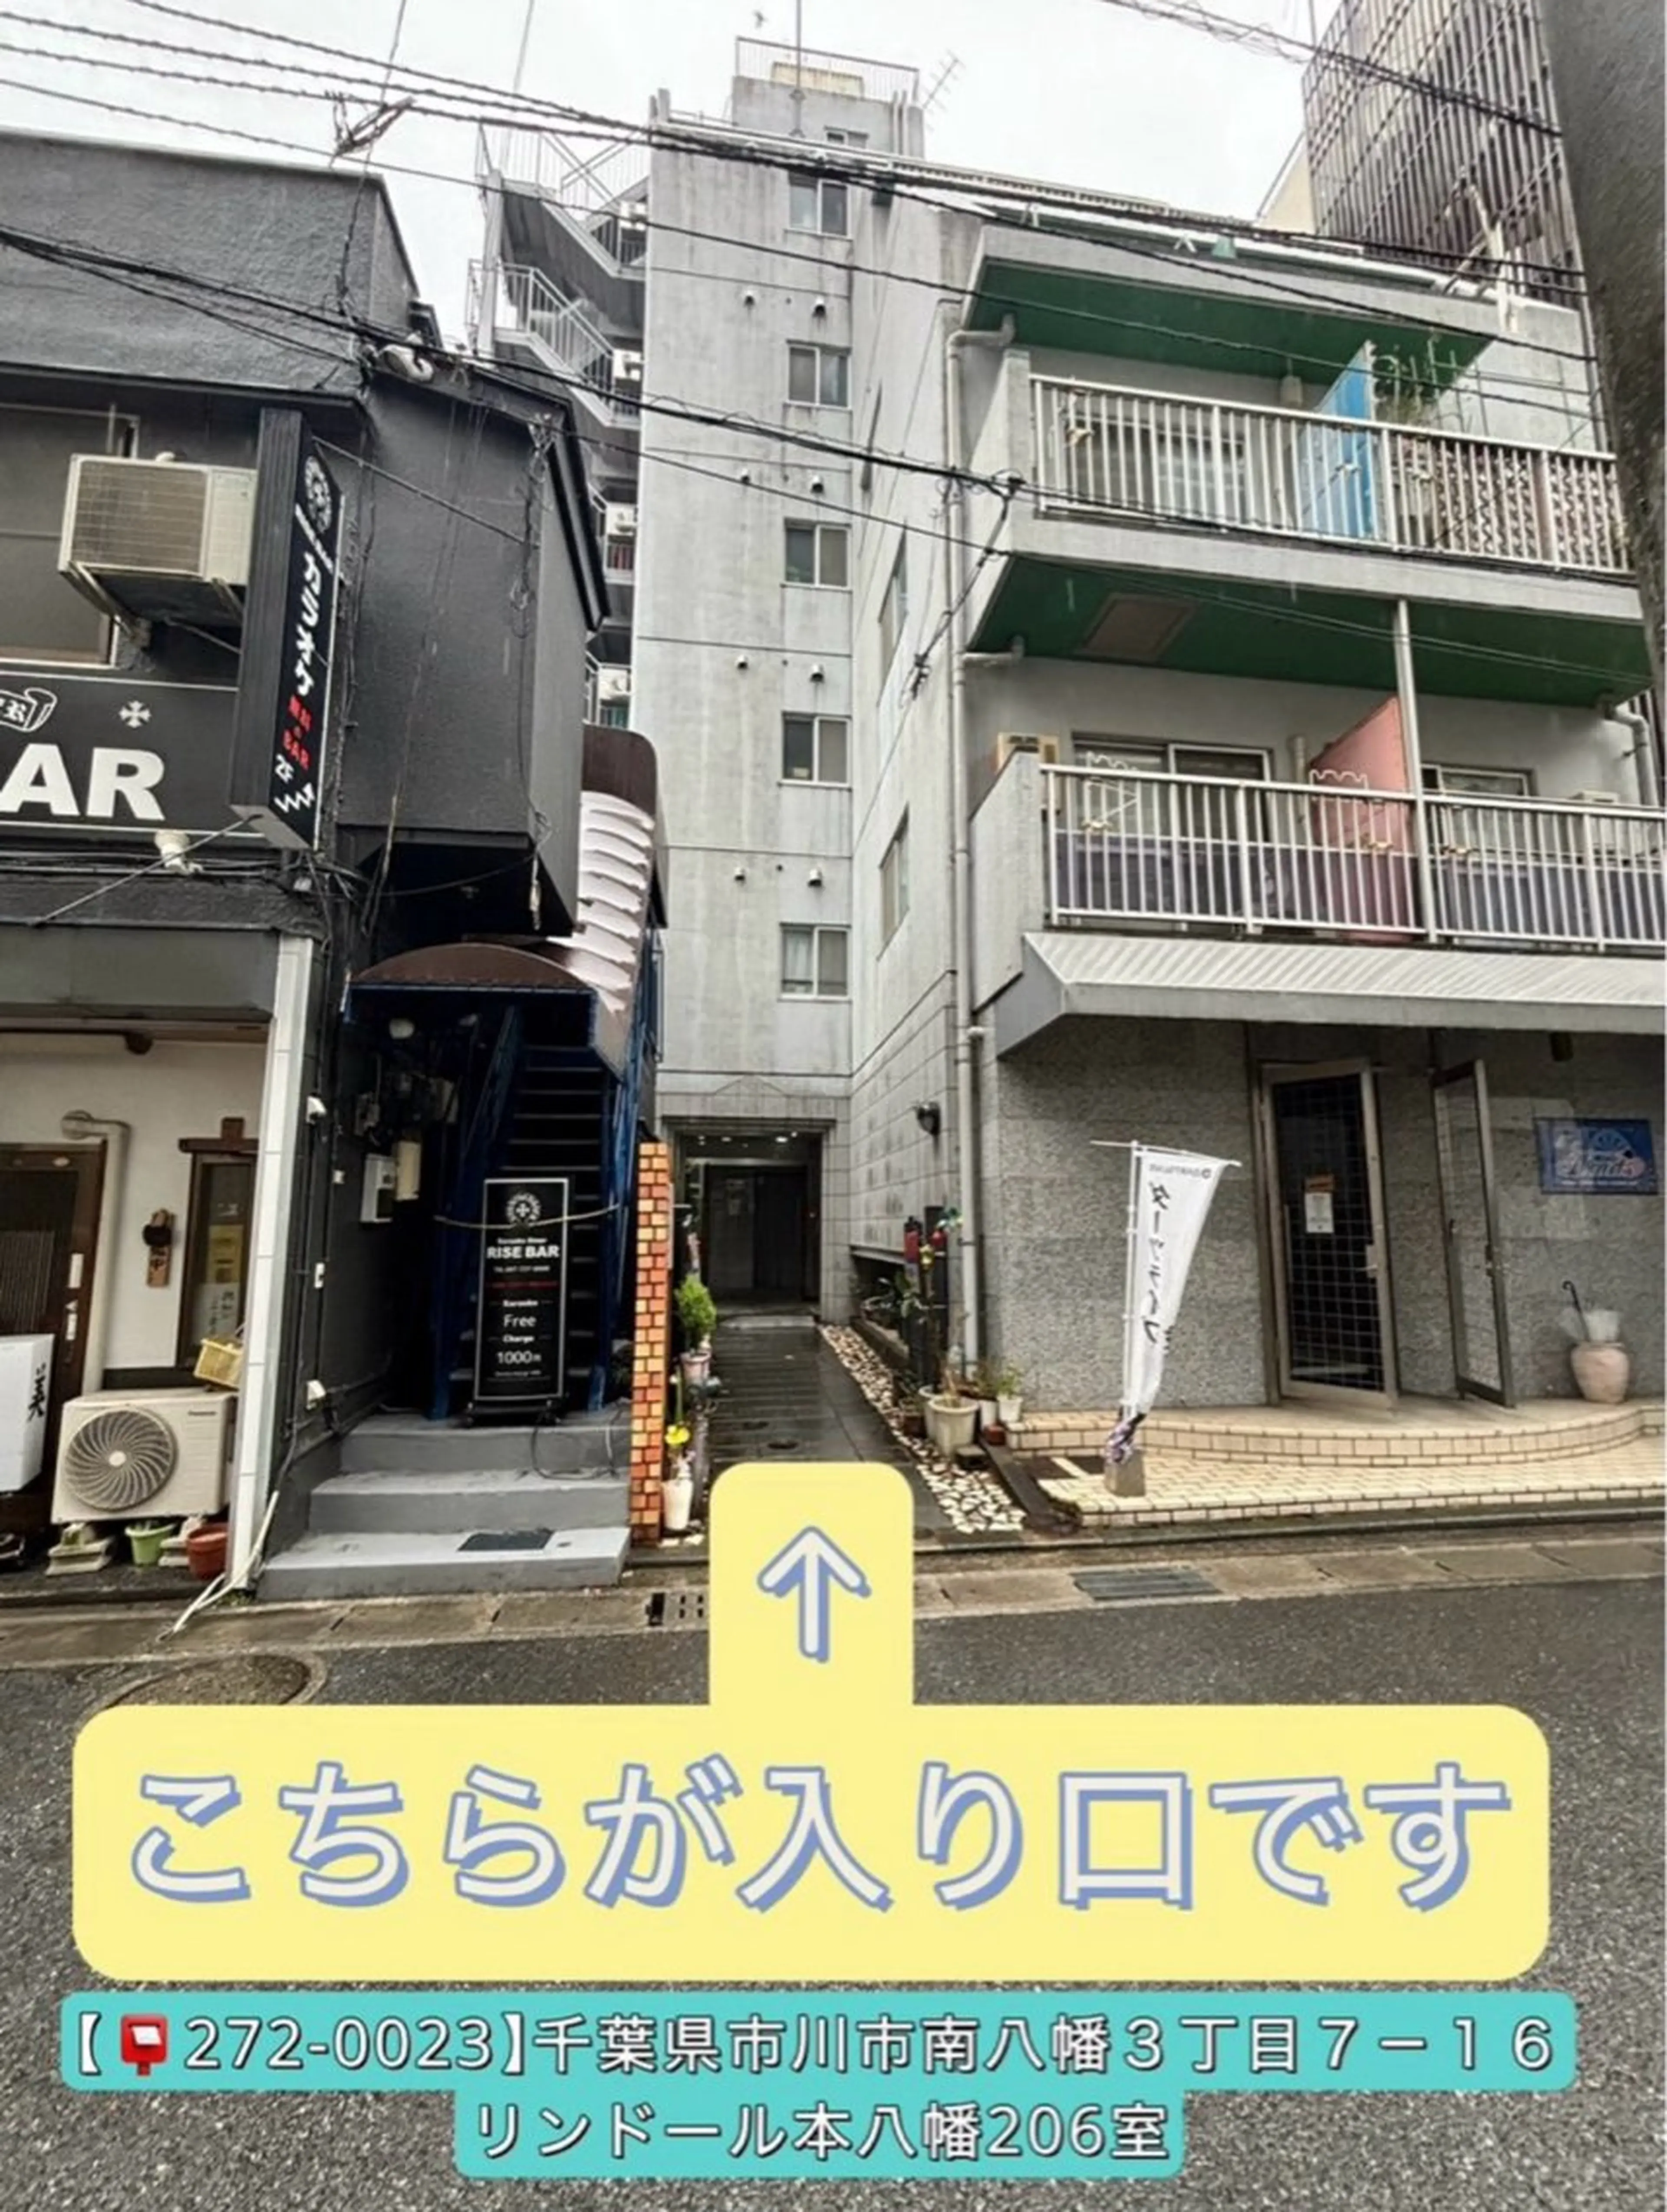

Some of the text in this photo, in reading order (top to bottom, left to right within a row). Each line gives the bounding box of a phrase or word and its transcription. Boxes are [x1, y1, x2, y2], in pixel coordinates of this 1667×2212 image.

[295, 550, 321, 696] カラオケ
[487, 1244, 560, 1259] RISE BAR
[503, 1313, 537, 1327] Free
[502, 1334, 535, 1344] Charge
